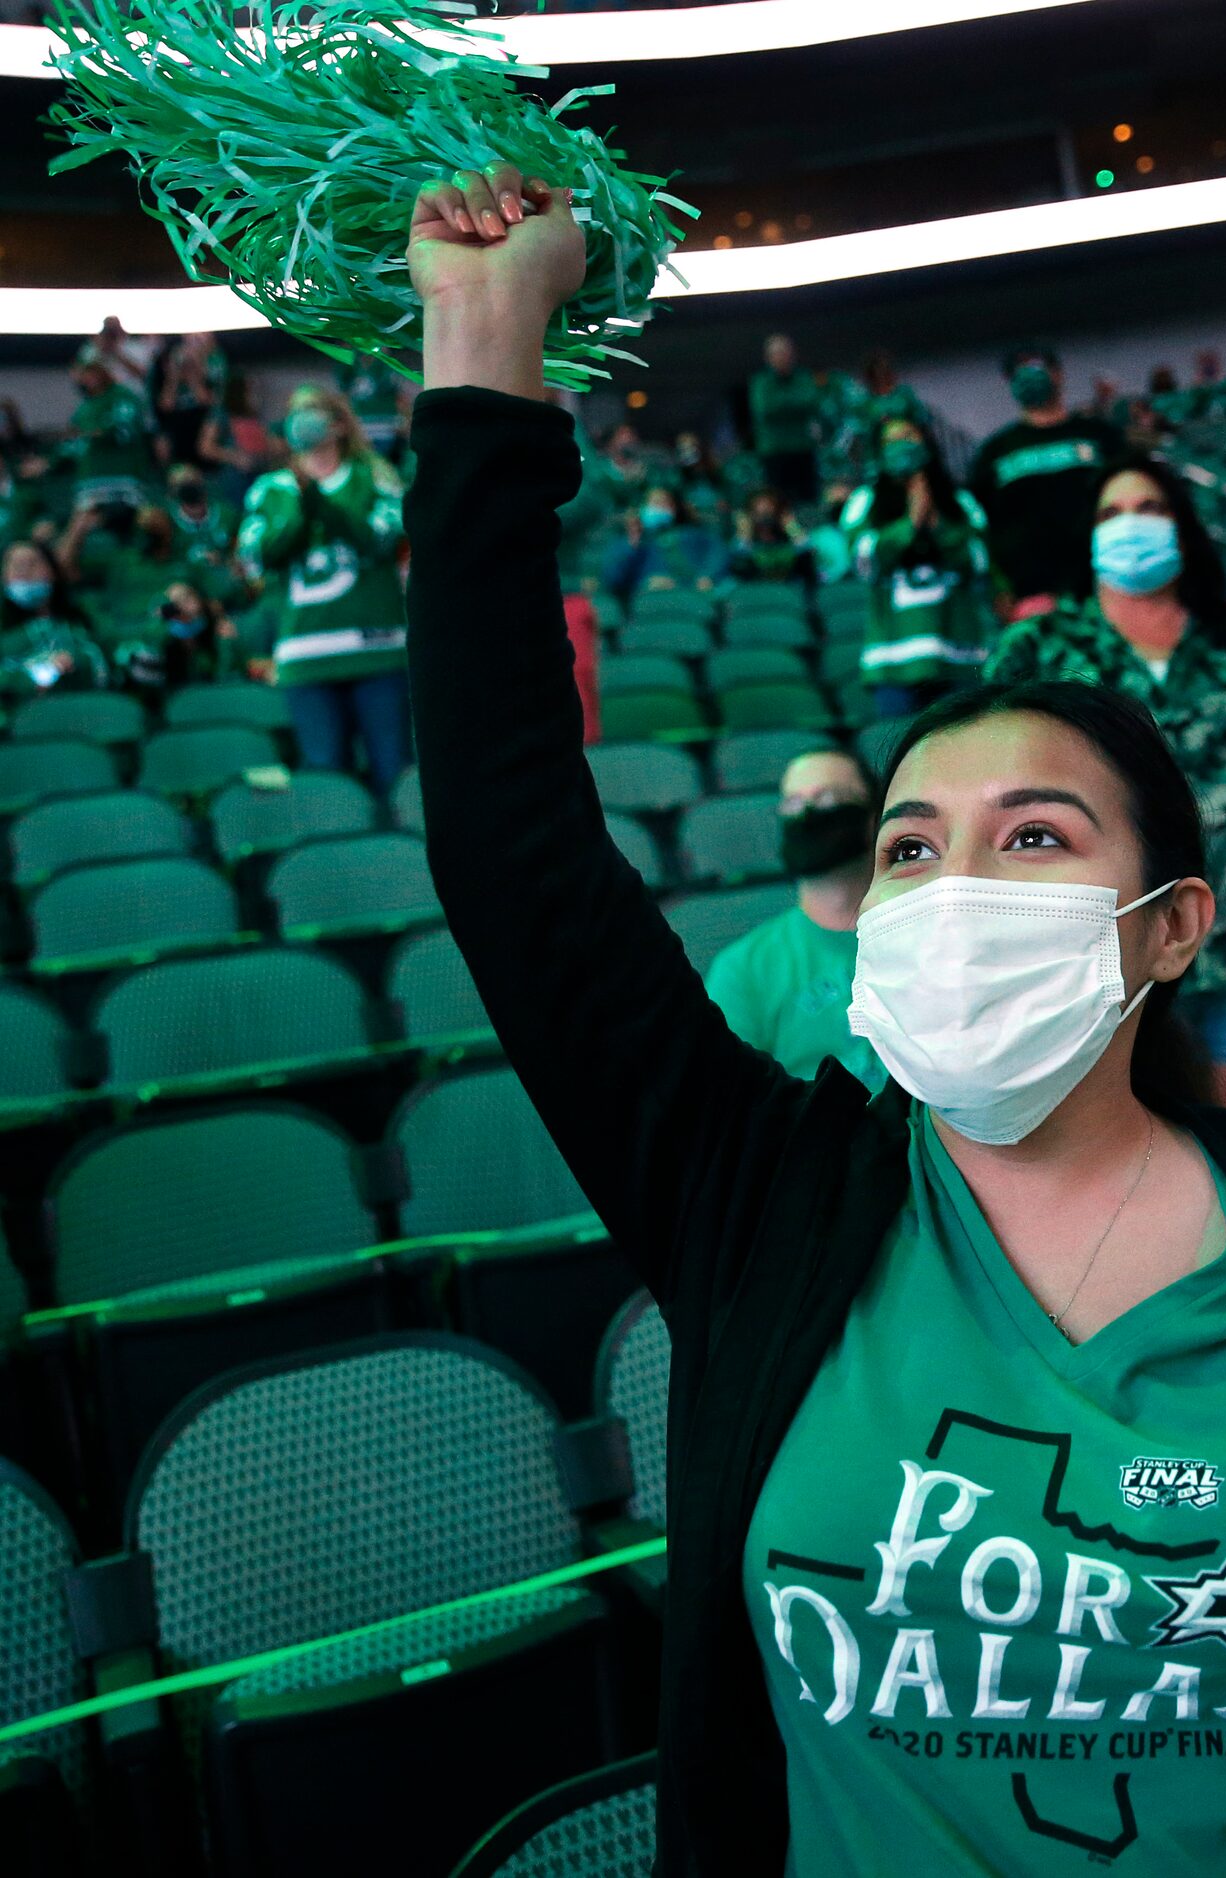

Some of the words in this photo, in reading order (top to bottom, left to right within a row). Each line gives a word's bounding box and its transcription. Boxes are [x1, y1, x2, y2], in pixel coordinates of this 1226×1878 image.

[1136, 1460, 1180, 1469] STANLEY
[1182, 1461, 1205, 1469] CUP
[1123, 1468, 1218, 1486] FINAL
[865, 1460, 1131, 1645] FOR
[955, 1731, 1099, 1760] STANLEY
